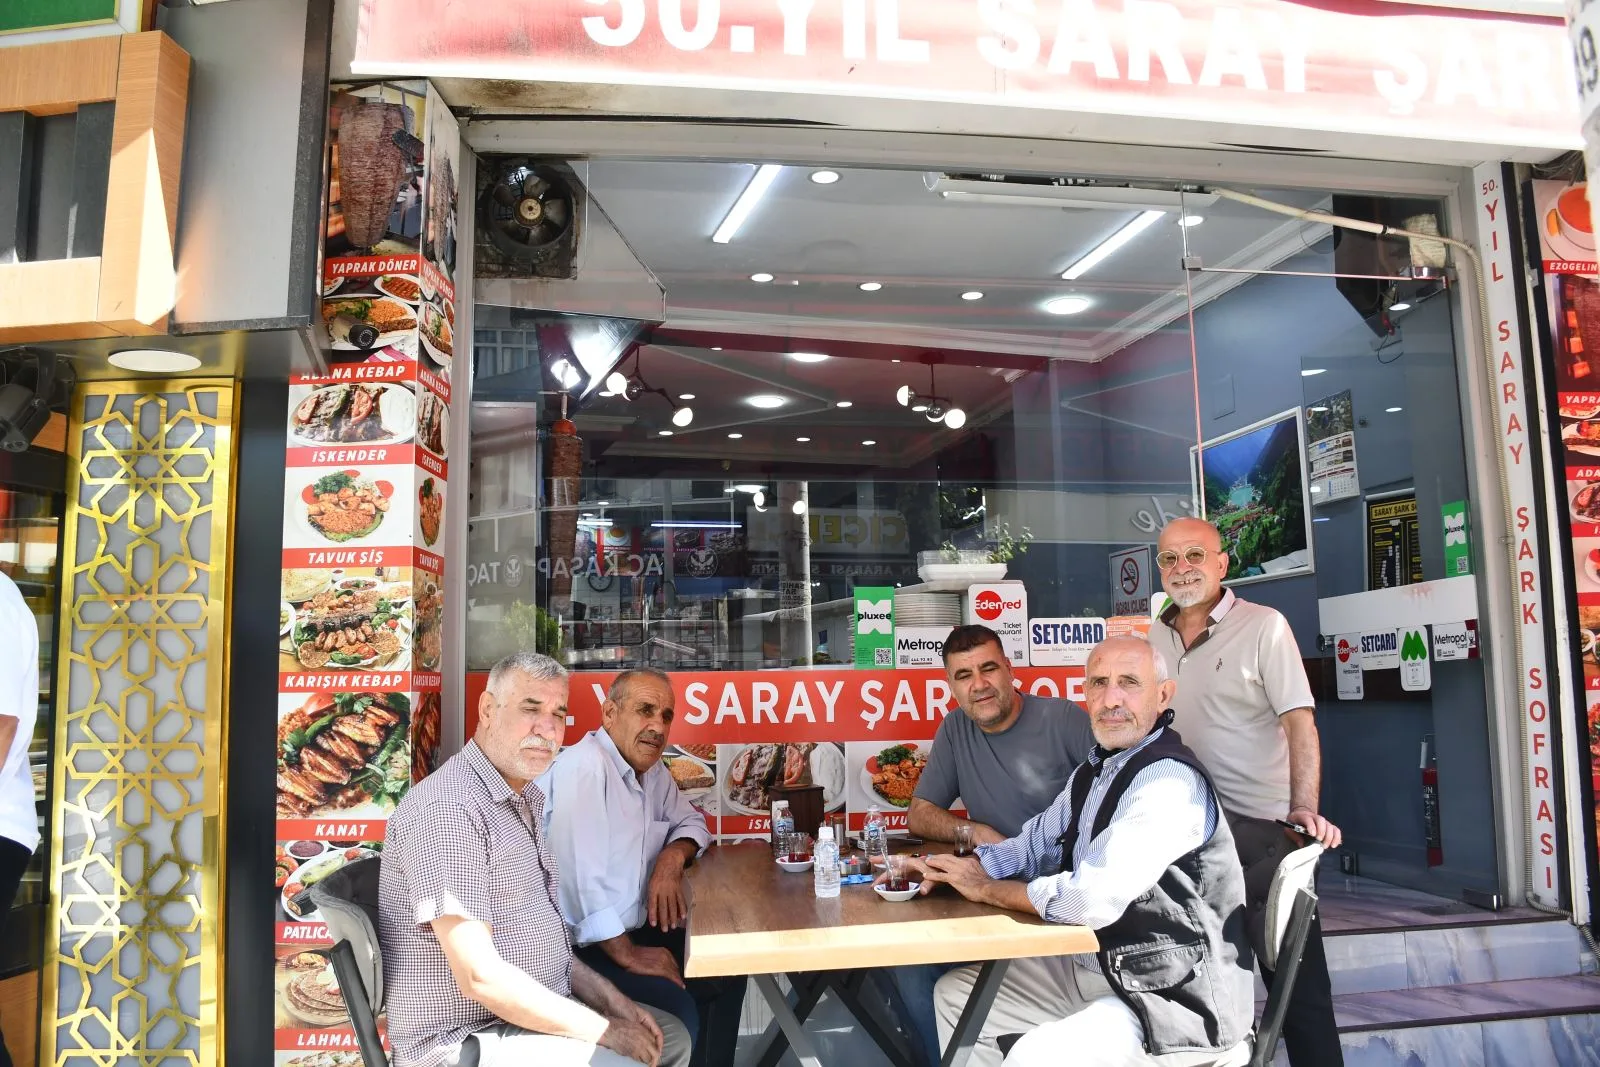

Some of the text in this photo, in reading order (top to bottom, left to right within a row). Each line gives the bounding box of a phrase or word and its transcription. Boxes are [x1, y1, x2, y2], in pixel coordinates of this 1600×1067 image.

[975, 0, 1306, 93] SARAY
[332, 257, 417, 274] YAPRAK DÖNER
[355, 365, 406, 379] KEBAP
[1482, 178, 1553, 889] 50. YIL SARAY ŞARK SOFRASI
[308, 549, 384, 565] TAVUK ŞİŞ
[975, 599, 1022, 610] Edenred
[857, 611, 892, 622] pluxee
[1032, 623, 1104, 645] SETCARD
[1434, 632, 1467, 645] Metropol
[1361, 632, 1397, 654] SETCARD
[285, 673, 403, 690] KARIŞIK KEBAP
[684, 680, 844, 726] SARAY
[315, 824, 368, 837] KANAT
